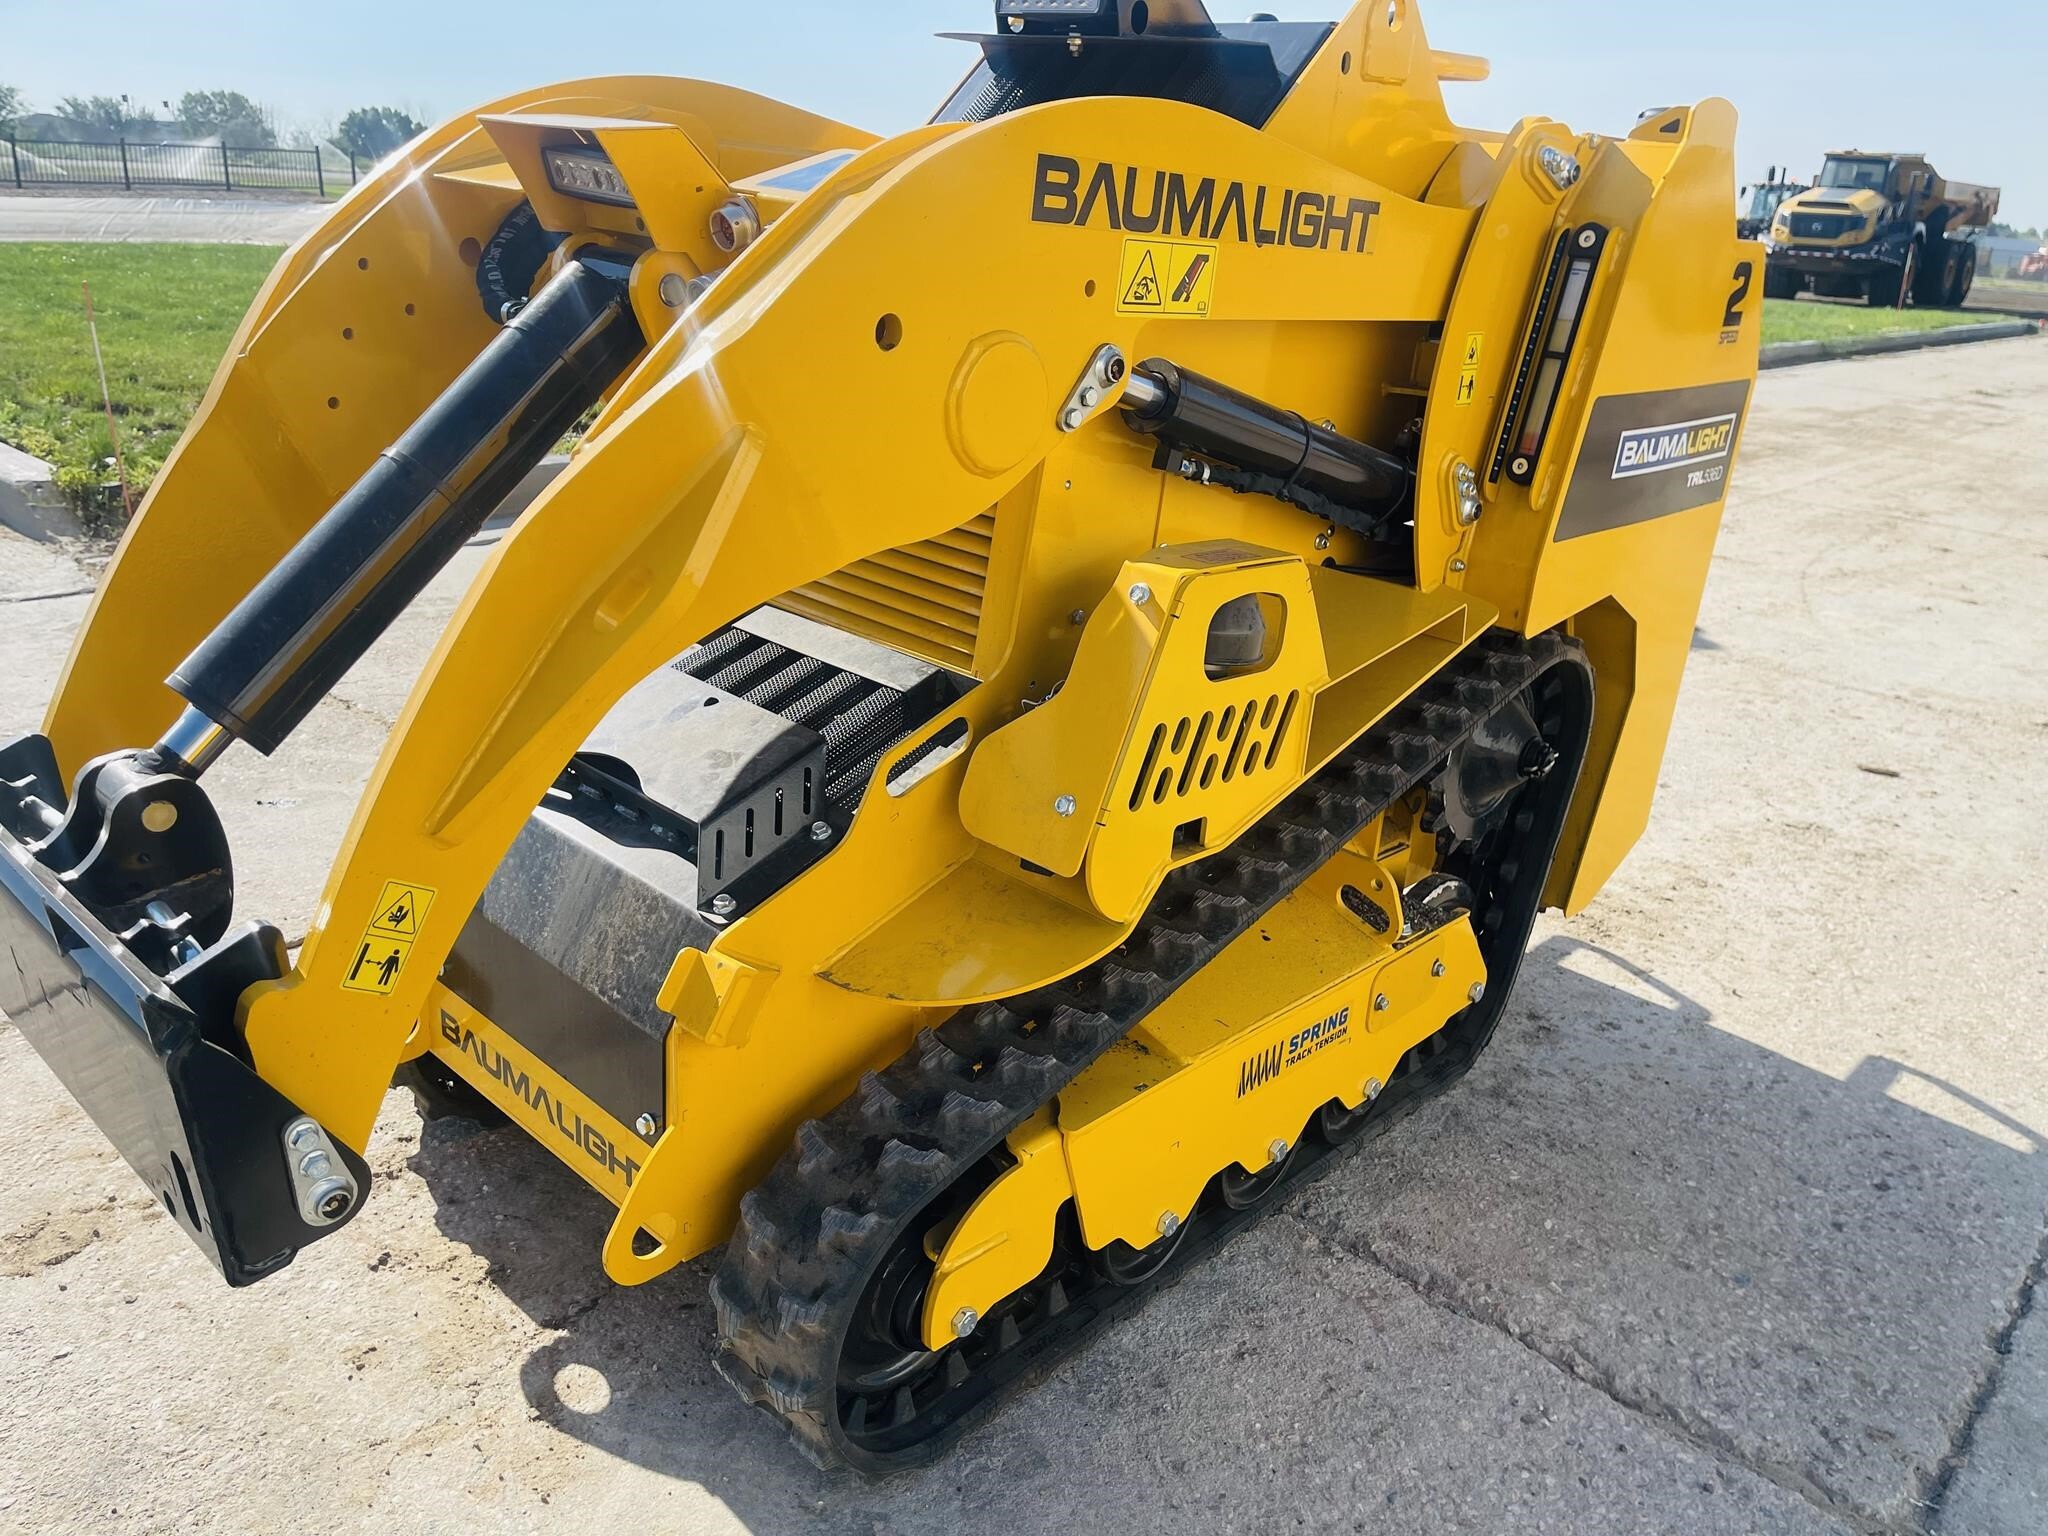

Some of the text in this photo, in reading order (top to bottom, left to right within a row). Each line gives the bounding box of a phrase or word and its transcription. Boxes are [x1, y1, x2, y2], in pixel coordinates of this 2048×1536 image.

[1031, 153, 1381, 254] BAUMALIGHT
[1722, 261, 1752, 327] 2
[1619, 423, 1731, 467] BAUMALIGHT
[1285, 1026, 1348, 1068] TRACK TENSION
[1288, 1007, 1349, 1054] SPRING
